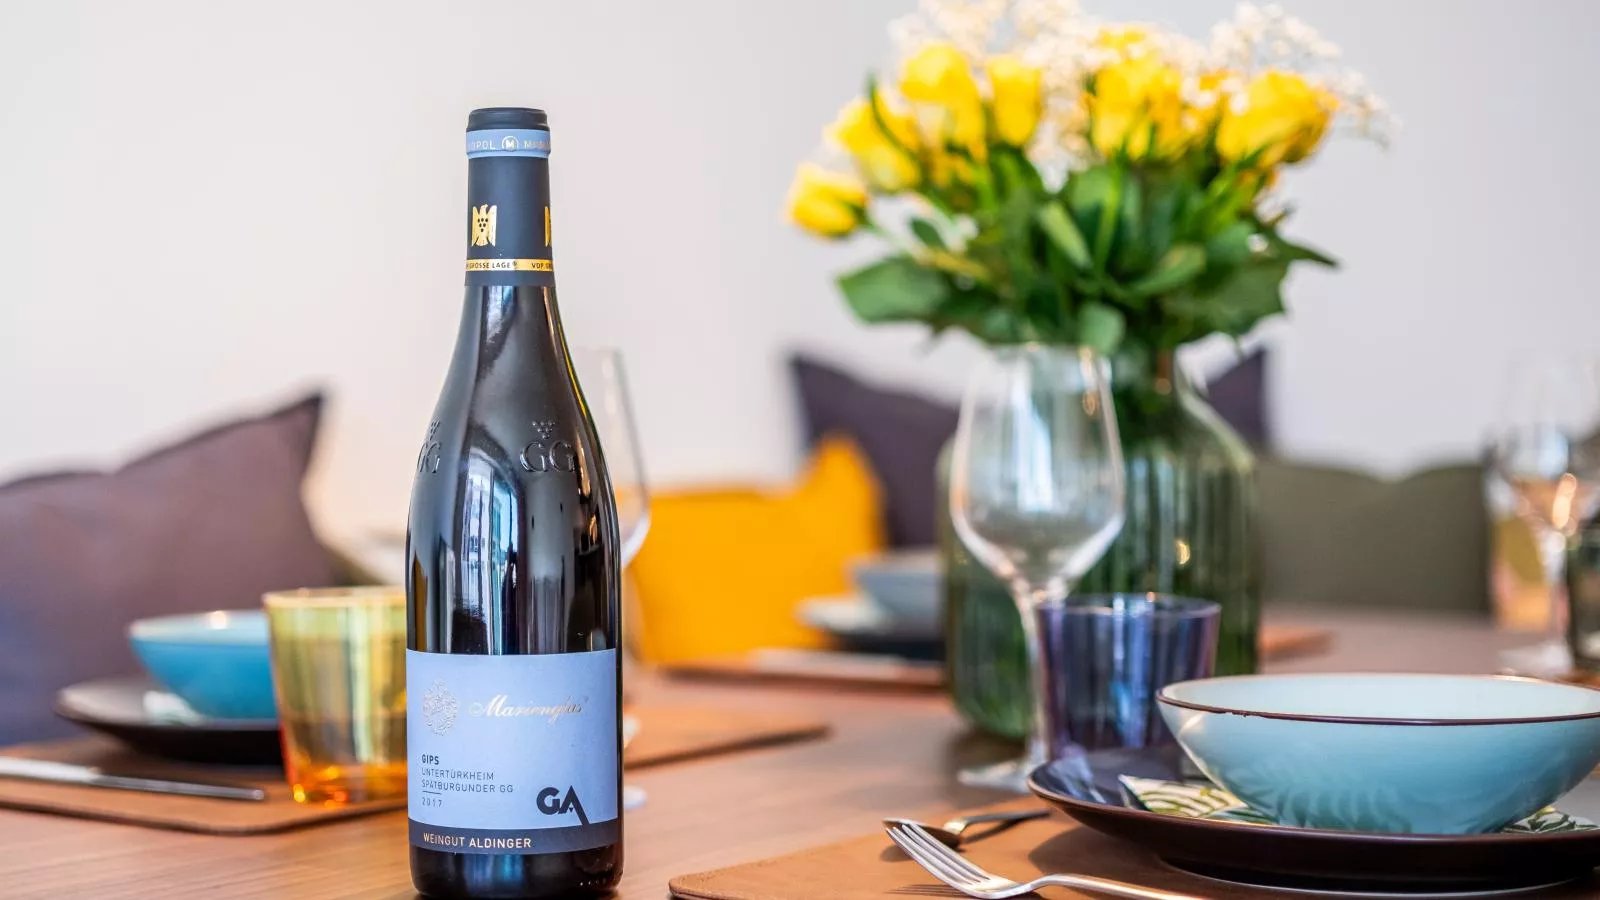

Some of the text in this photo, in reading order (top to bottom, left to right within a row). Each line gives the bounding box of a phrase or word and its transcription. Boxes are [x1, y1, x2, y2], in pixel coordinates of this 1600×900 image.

[492, 261, 511, 269] LAGE
[519, 440, 576, 473] GG
[421, 753, 440, 766] GIPS
[499, 784, 514, 793] GG
[421, 796, 443, 807] 2017
[423, 832, 533, 849] WEINGUT ALDINGER
